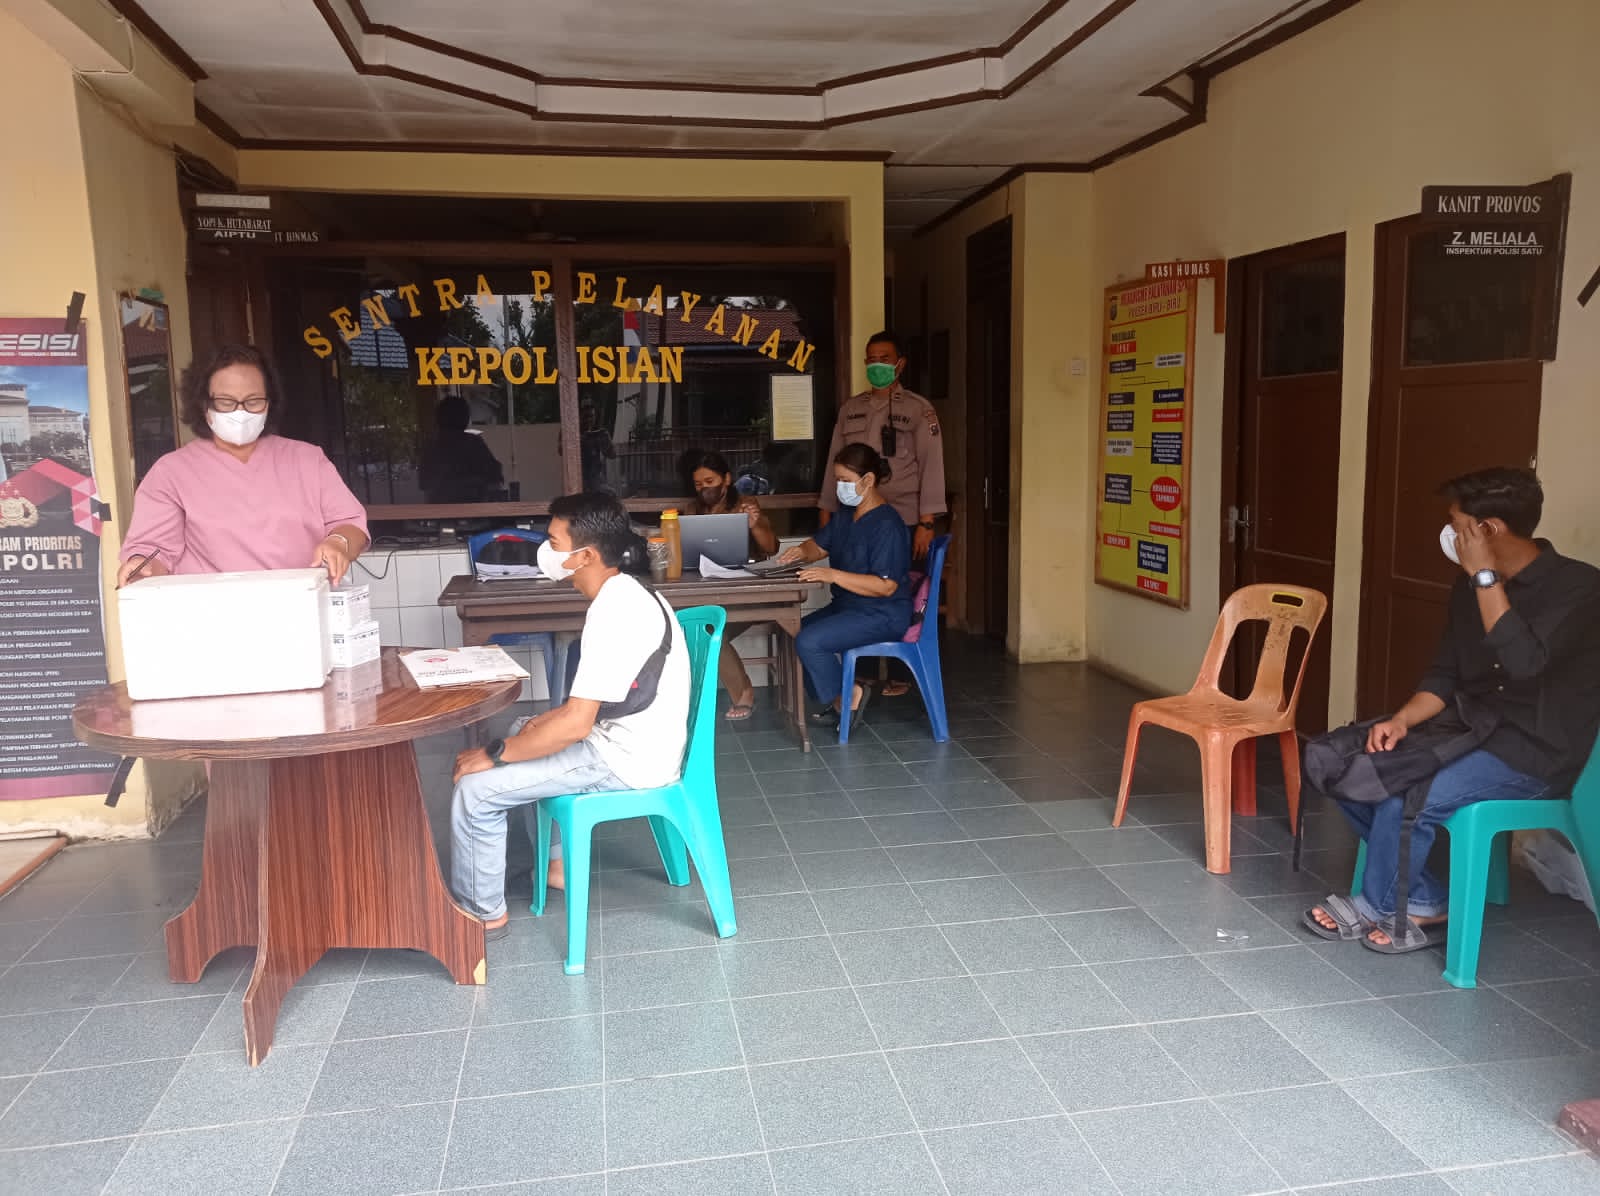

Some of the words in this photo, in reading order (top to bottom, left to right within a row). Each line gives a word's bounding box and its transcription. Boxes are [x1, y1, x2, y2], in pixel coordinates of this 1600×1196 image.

[1438, 195, 1481, 213] KANIT
[1486, 195, 1542, 213] PROVOS
[227, 218, 272, 230] HUTABARAT
[214, 231, 256, 239] AIPTU
[1451, 231, 1466, 245] Z.
[1470, 231, 1538, 245] MELIALA
[1446, 247, 1492, 255] INSPEKTUR
[1493, 247, 1519, 255] POLISI
[1520, 247, 1543, 255] SATU
[1151, 264, 1173, 278] KASI
[1177, 262, 1210, 277] HUMAS
[303, 273, 497, 359] SENTRA
[531, 270, 816, 373] PELAYANAN
[25, 535, 82, 551] PRIORITAS
[0, 553, 83, 571] POLRI
